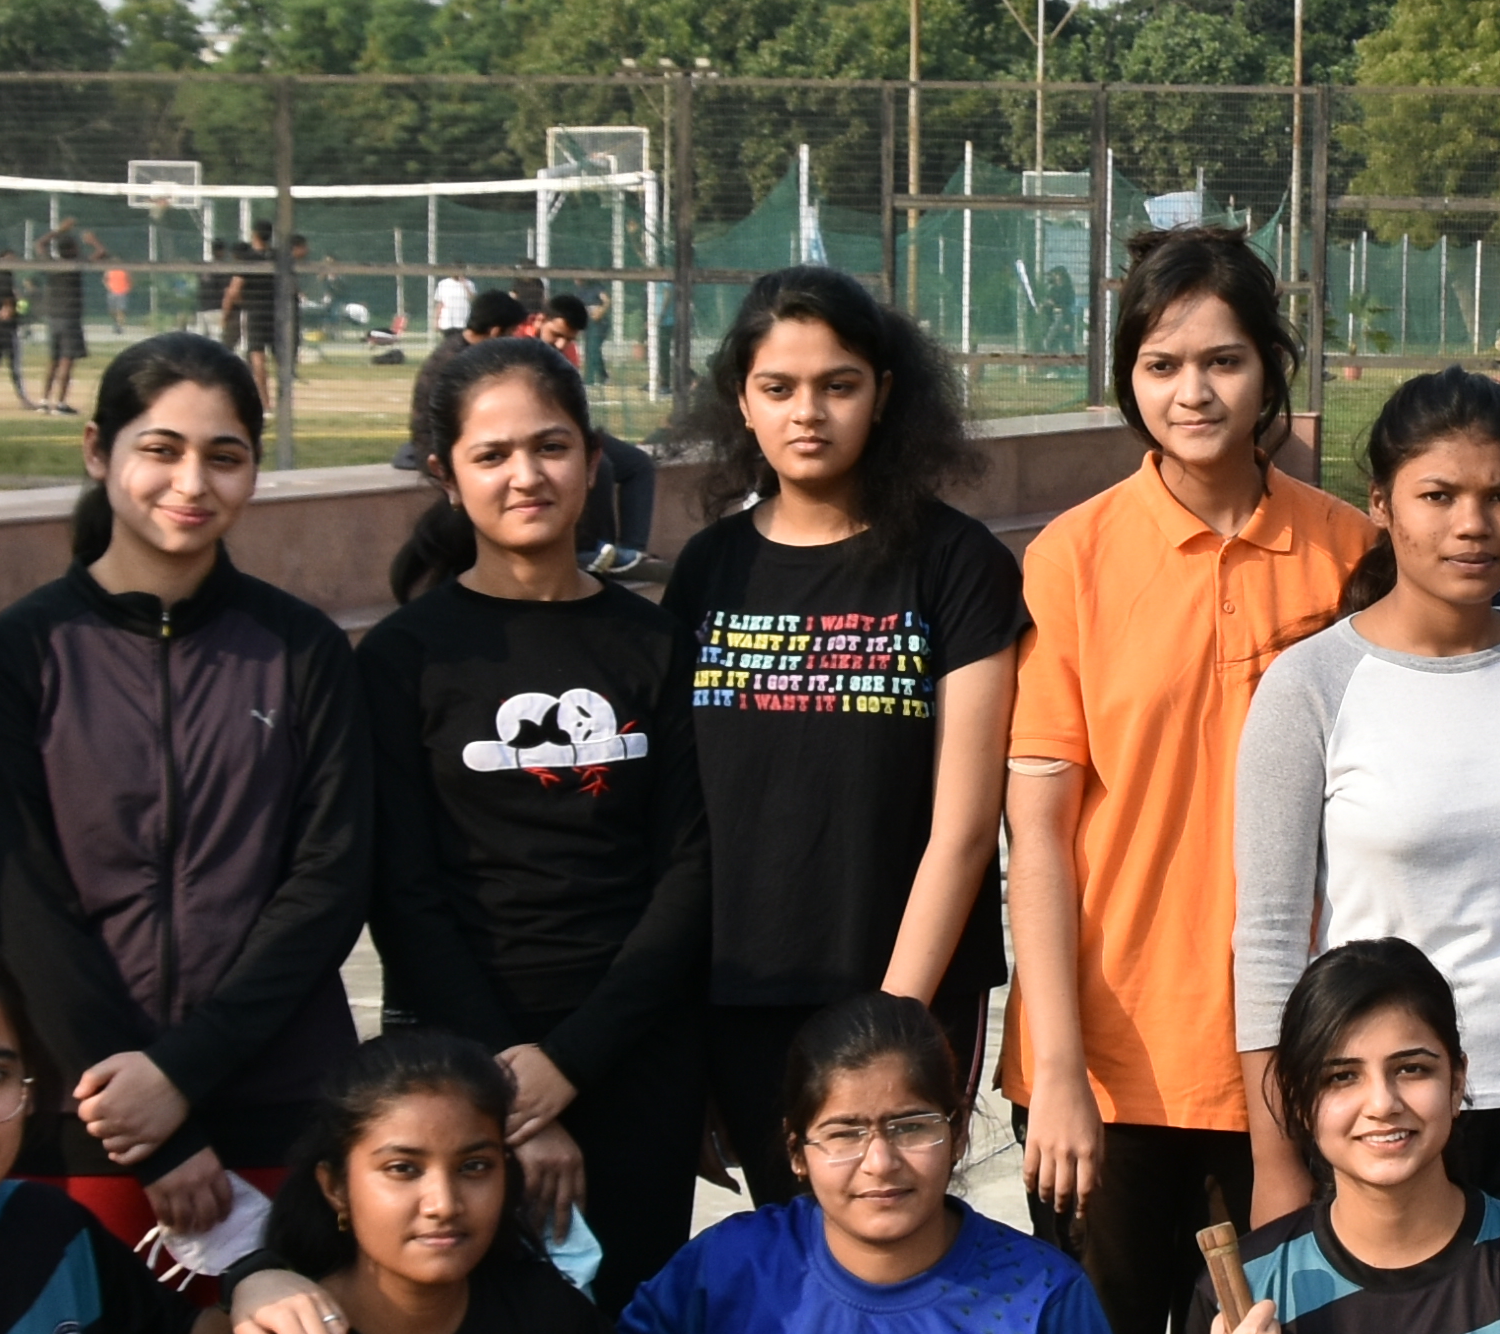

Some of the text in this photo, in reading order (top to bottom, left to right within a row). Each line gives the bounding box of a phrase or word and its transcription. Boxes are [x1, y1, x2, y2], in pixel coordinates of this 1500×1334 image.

[714, 611, 725, 626] I
[728, 614, 774, 631] LIKE
[777, 615, 801, 632] IT
[806, 616, 814, 631] I
[821, 613, 875, 632] WANT
[879, 613, 898, 631] IT
[710, 629, 721, 645] I
[727, 632, 784, 651] WANT
[788, 635, 810, 651] IT
[739, 653, 775, 670] SEE
[778, 655, 803, 670] IT
[806, 655, 815, 669] I
[820, 653, 863, 670] LIKE
[868, 654, 891, 670] IT
[726, 670, 750, 688] IT
[753, 673, 762, 690] I
[767, 674, 803, 691] GOT
[849, 675, 885, 693] SEE
[892, 677, 916, 696] IT
[713, 689, 734, 706] IT
[754, 693, 810, 712] WANT
[815, 695, 836, 712] IT
[856, 695, 896, 715] GOT
